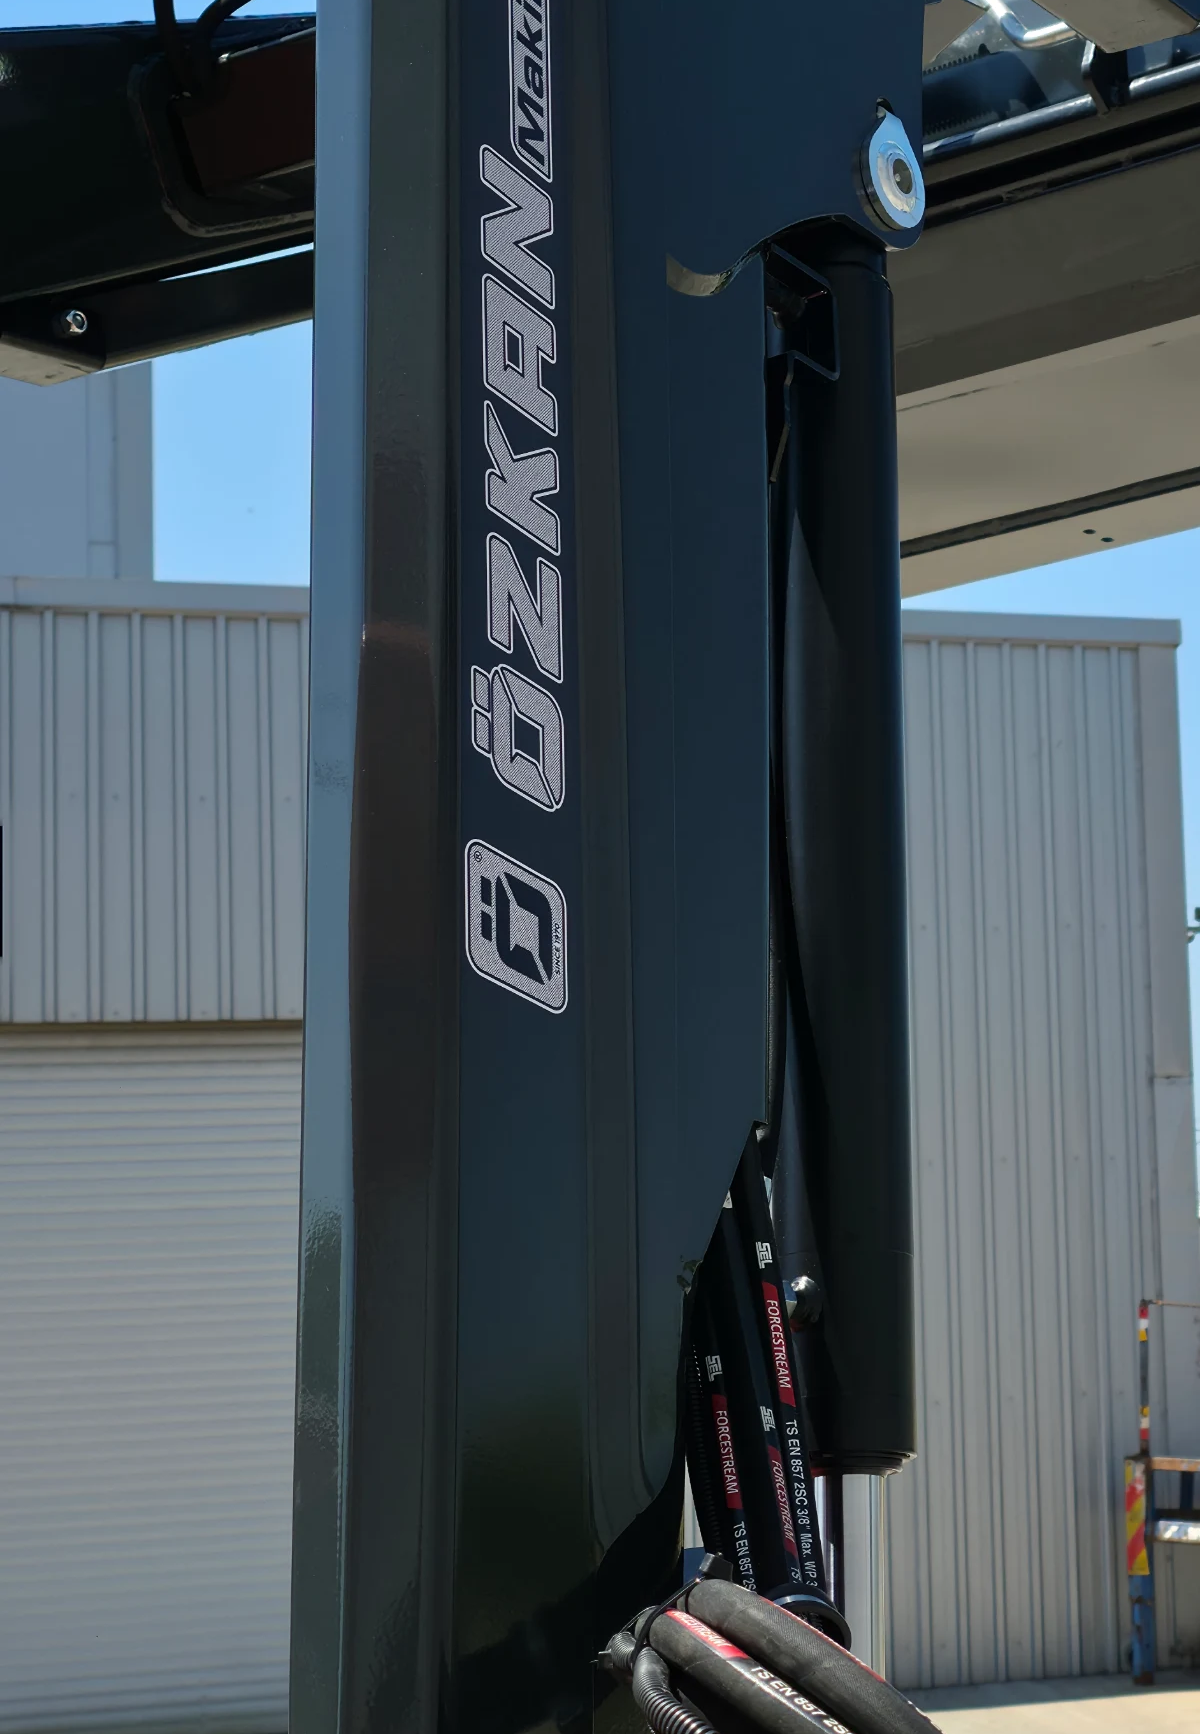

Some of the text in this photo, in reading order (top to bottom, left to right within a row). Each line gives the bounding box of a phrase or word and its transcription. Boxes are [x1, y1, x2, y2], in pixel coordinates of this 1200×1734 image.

[472, 143, 566, 812] ÖZKAN
[554, 945, 562, 975] SINCE
[756, 1241, 773, 1269] SEL
[766, 1299, 792, 1389] FORCESTREAM
[705, 1354, 723, 1382] SEL
[760, 1405, 776, 1432] SEL
[785, 1419, 799, 1436] TS
[716, 1410, 739, 1495] FORCESTREAM
[788, 1438, 801, 1456] EN
[790, 1459, 805, 1479] 857
[772, 1459, 796, 1544] FORCESTREAM
[793, 1482, 808, 1507] 2SC
[733, 1521, 746, 1537] TS
[735, 1539, 750, 1557] EN
[800, 1531, 812, 1558] Max.
[738, 1557, 753, 1575] 857
[803, 1560, 818, 1581] WP
[750, 1666, 771, 1680] TS
[772, 1680, 796, 1697] EN
[793, 1696, 828, 1717] 857
